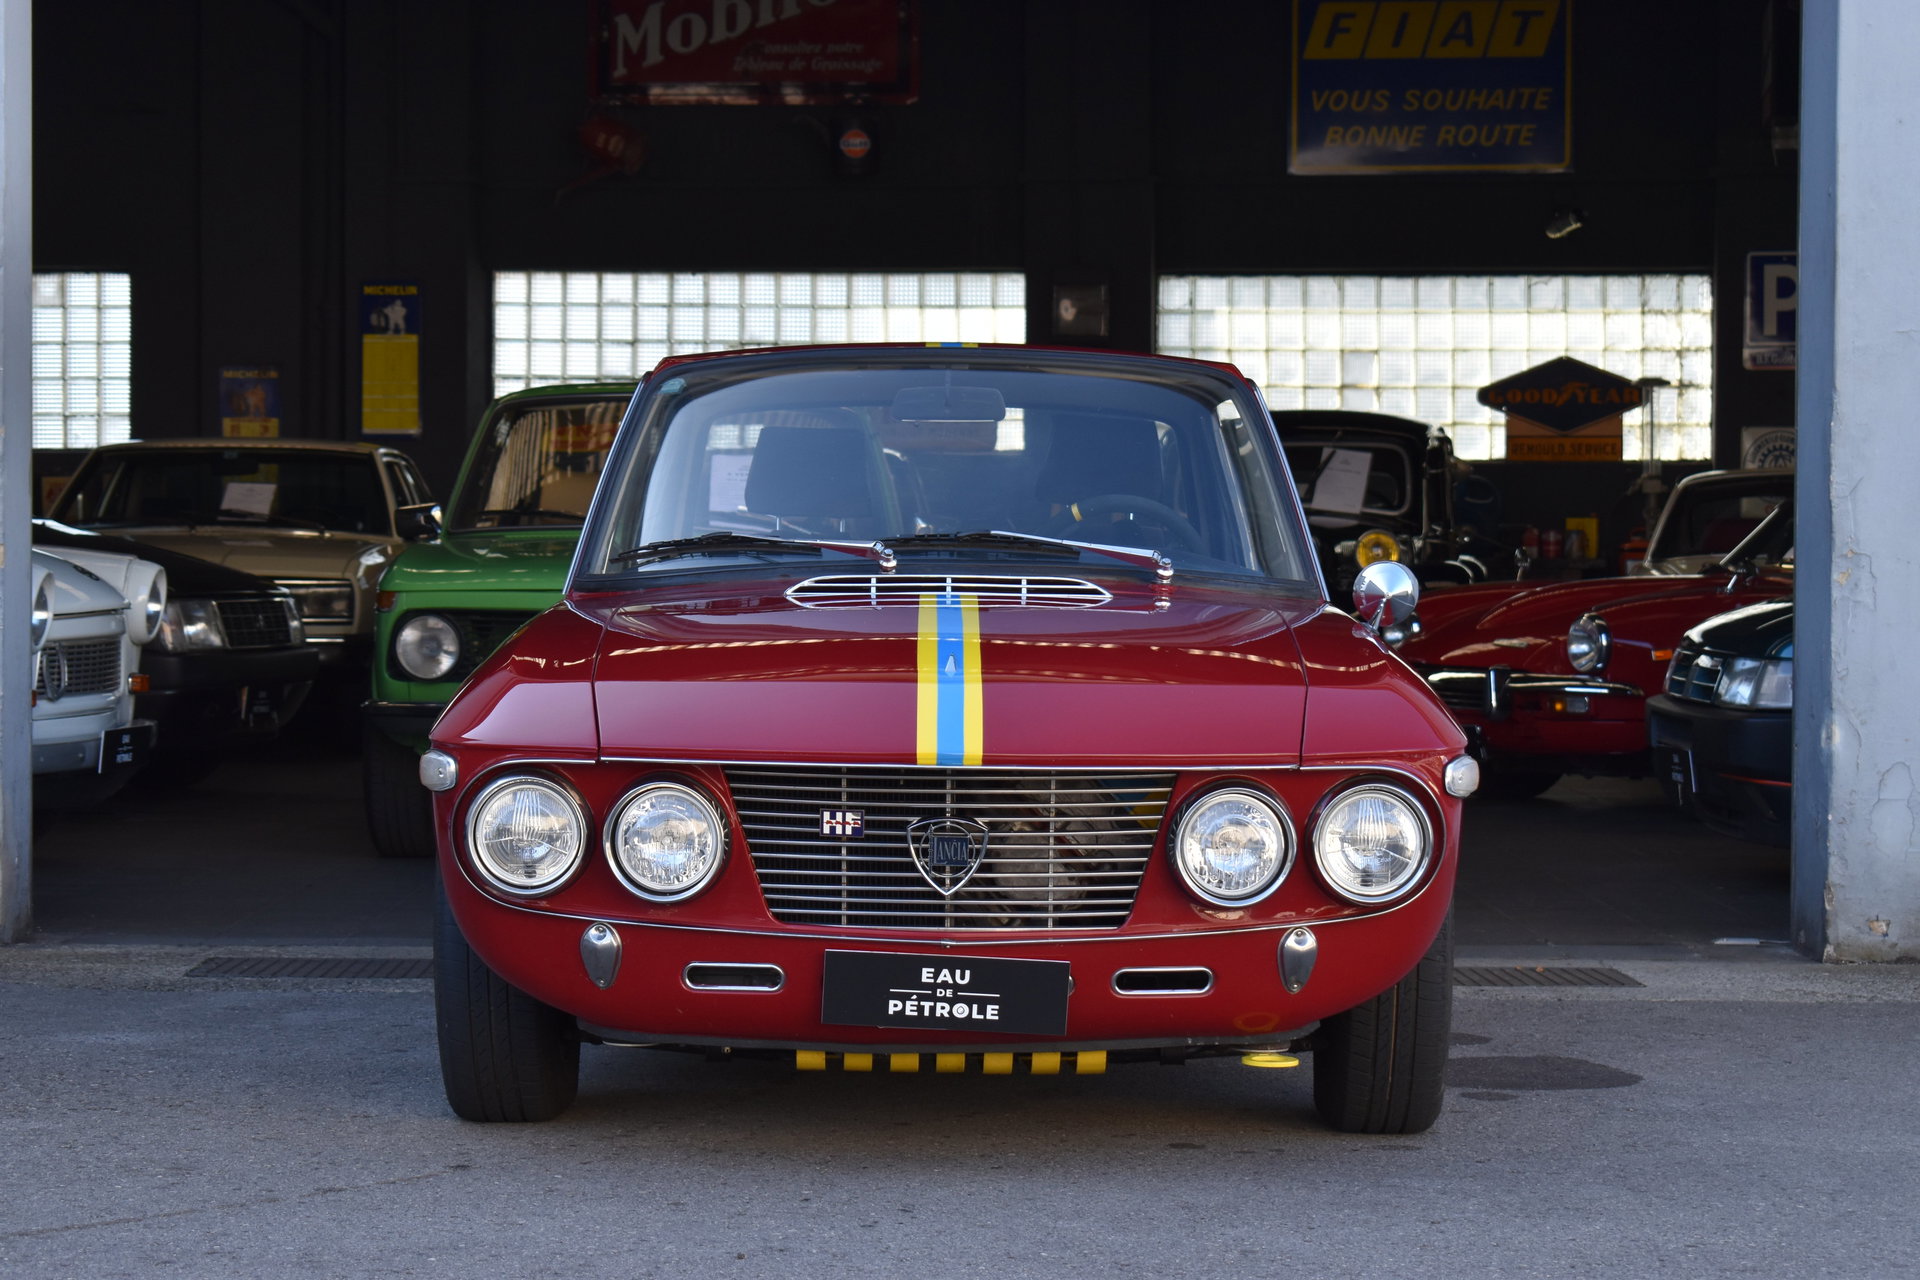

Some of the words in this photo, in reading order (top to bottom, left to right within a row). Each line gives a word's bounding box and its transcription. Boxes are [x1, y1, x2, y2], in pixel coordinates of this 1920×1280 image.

[1323, 10, 1546, 49] FIAT
[1311, 89, 1391, 112] VOUS
[1402, 87, 1552, 111] SOUHAITE
[1323, 125, 1426, 147] BONNE
[1435, 124, 1537, 146] ROUTE
[363, 285, 418, 296] MICHELIN
[1763, 264, 1796, 337] P
[1488, 383, 1641, 407] GOODYEAR
[823, 811, 861, 834] HF
[933, 836, 968, 865] LANCIA
[921, 967, 971, 985] EAU
[936, 988, 953, 998] DE
[888, 994, 1000, 1020] PÉTROLE
